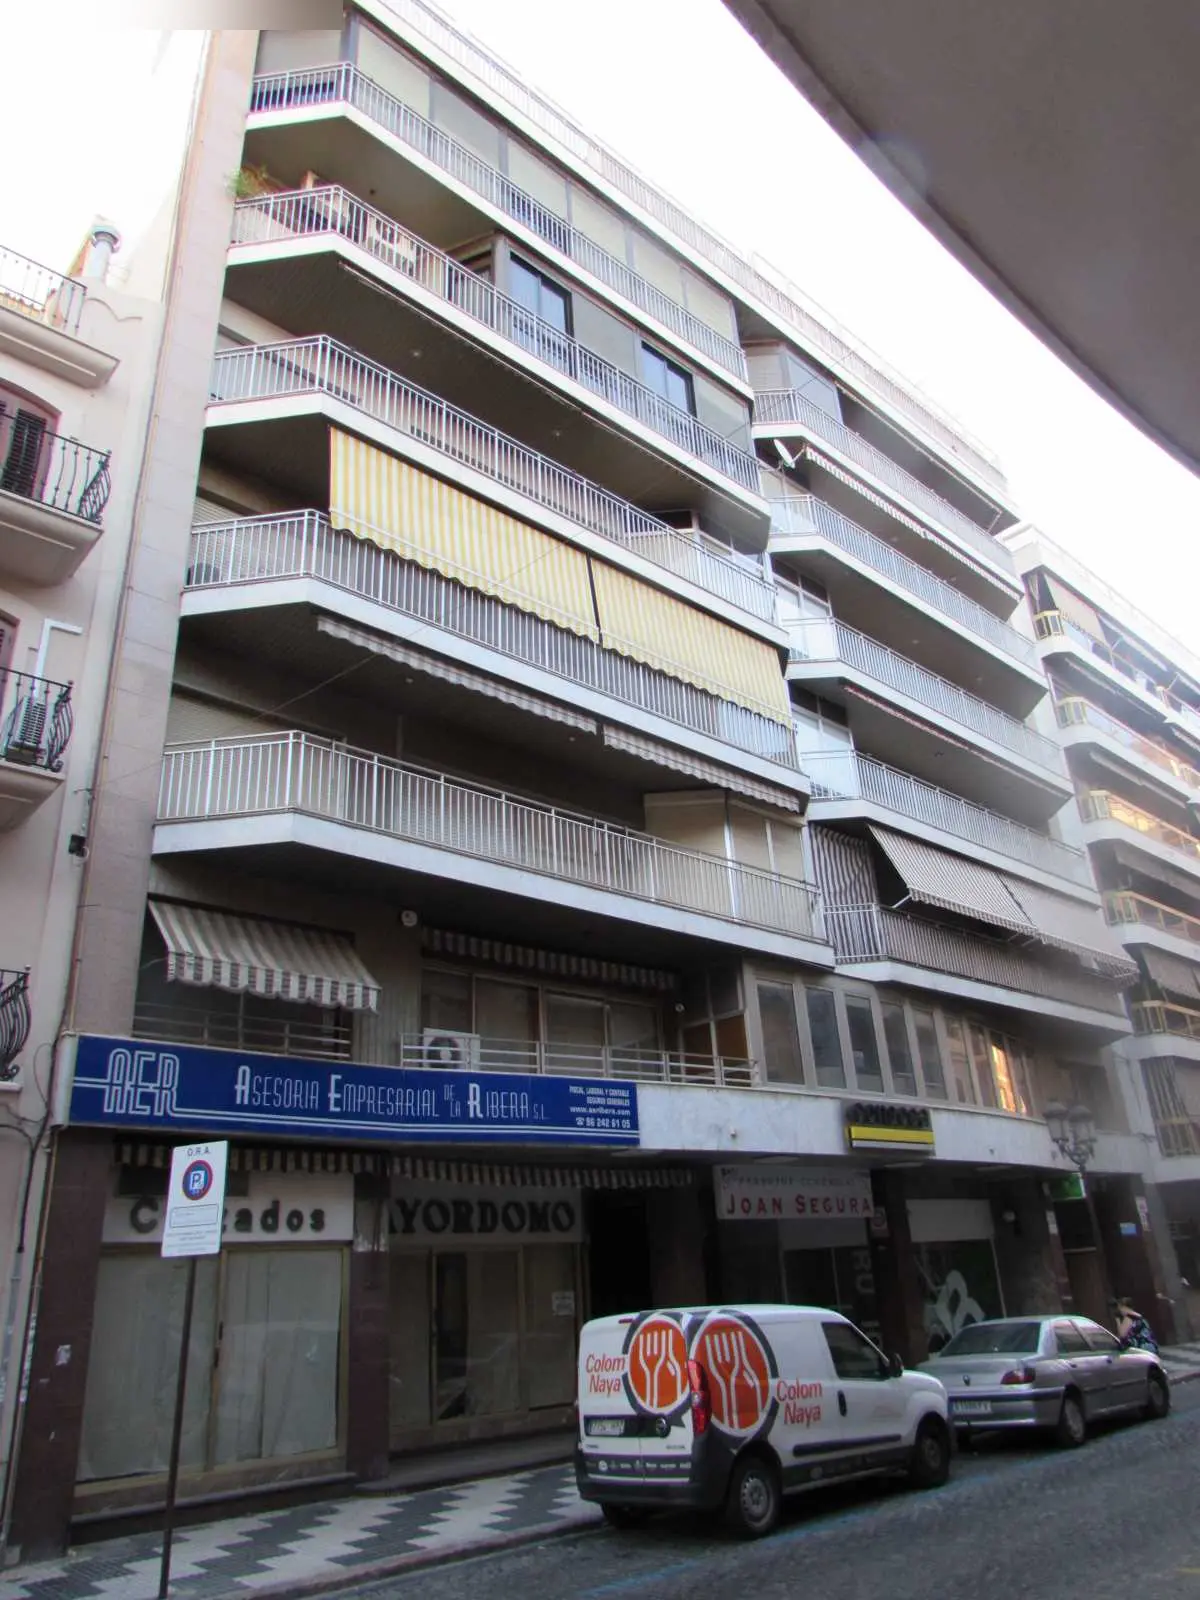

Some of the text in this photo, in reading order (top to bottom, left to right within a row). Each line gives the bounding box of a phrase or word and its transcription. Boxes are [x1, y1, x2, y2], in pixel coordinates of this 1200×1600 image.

[104, 1048, 179, 1116] AER
[234, 1065, 319, 1110] ASESORIA
[328, 1074, 440, 1117] EMPRESARIAL
[443, 1084, 455, 1100] DE
[450, 1101, 460, 1118] LA
[467, 1082, 529, 1119] RIBERA
[130, 1197, 325, 1234] Cados
[727, 1193, 872, 1214] JOAN SEGURA
[586, 1353, 625, 1373] Colom
[590, 1374, 621, 1398] Naya
[777, 1378, 823, 1401] Colom
[784, 1400, 822, 1429] Naya
